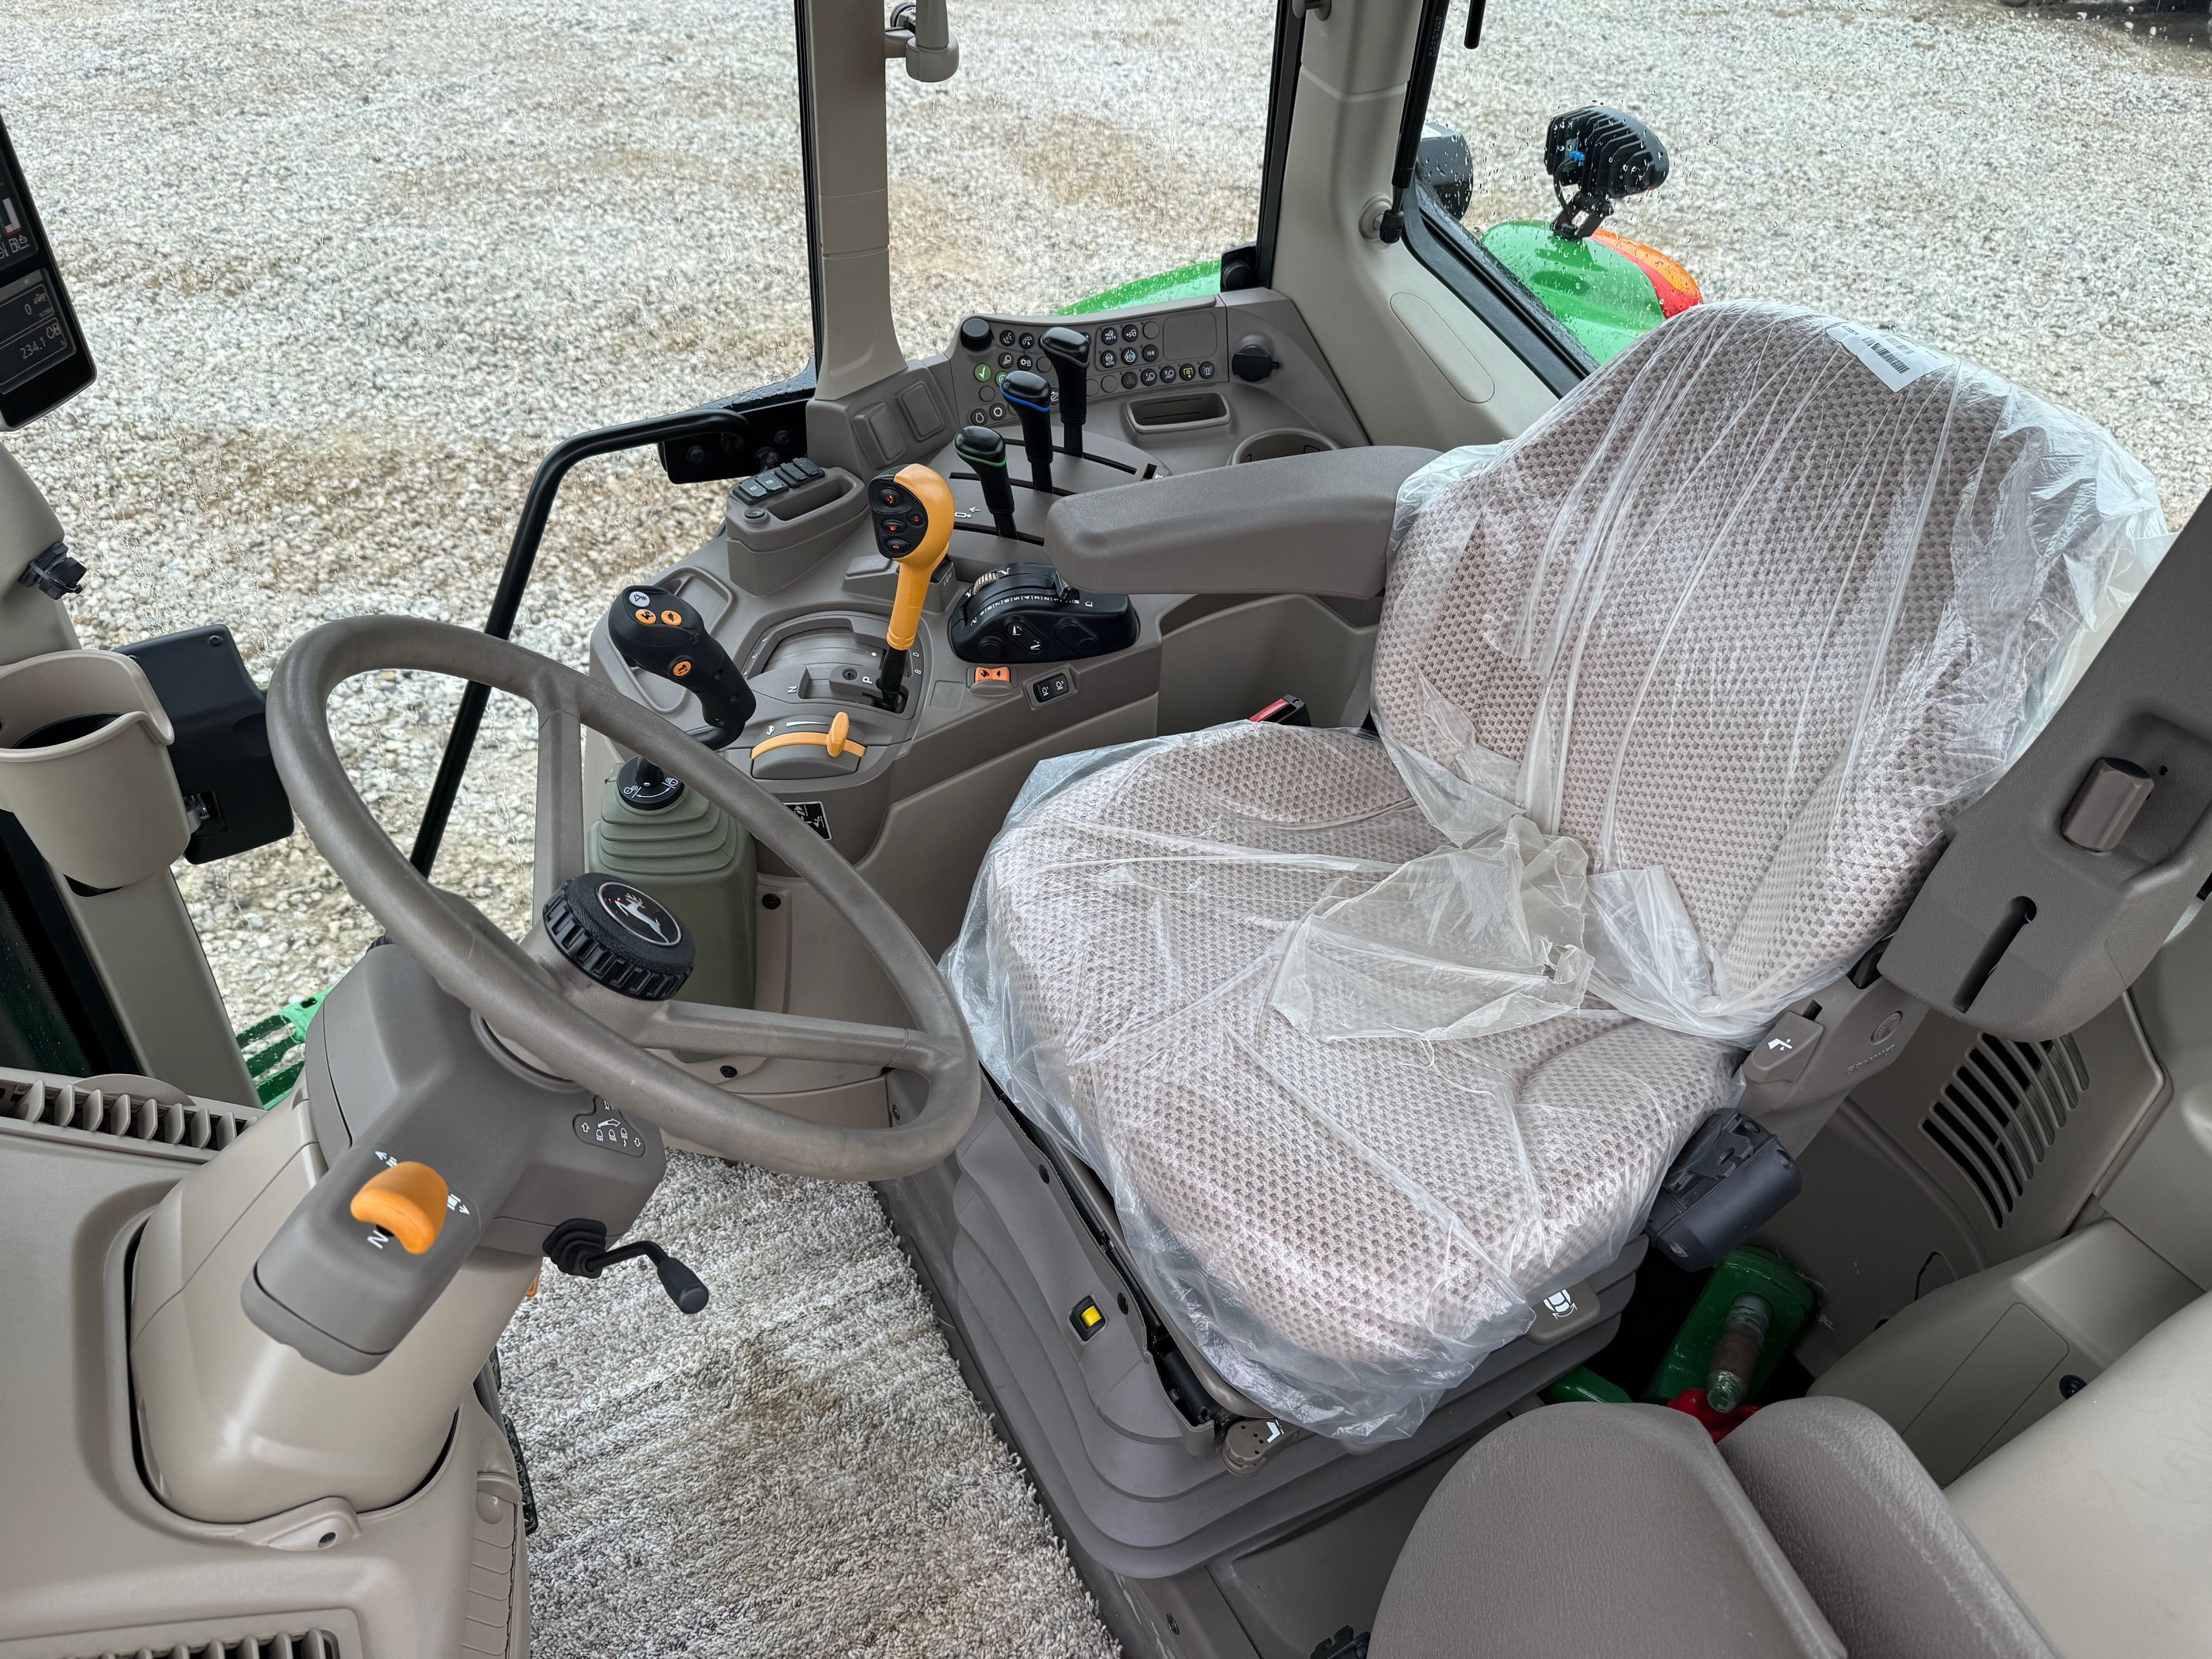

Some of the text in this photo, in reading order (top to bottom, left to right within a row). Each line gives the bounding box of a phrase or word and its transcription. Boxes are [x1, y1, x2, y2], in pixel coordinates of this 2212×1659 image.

[1428, 15, 1439, 57] STABILUS
[24, 304, 32, 315] 0
[19, 336, 46, 360] 234.1
[862, 676, 873, 685] P
[367, 1230, 389, 1249] N
